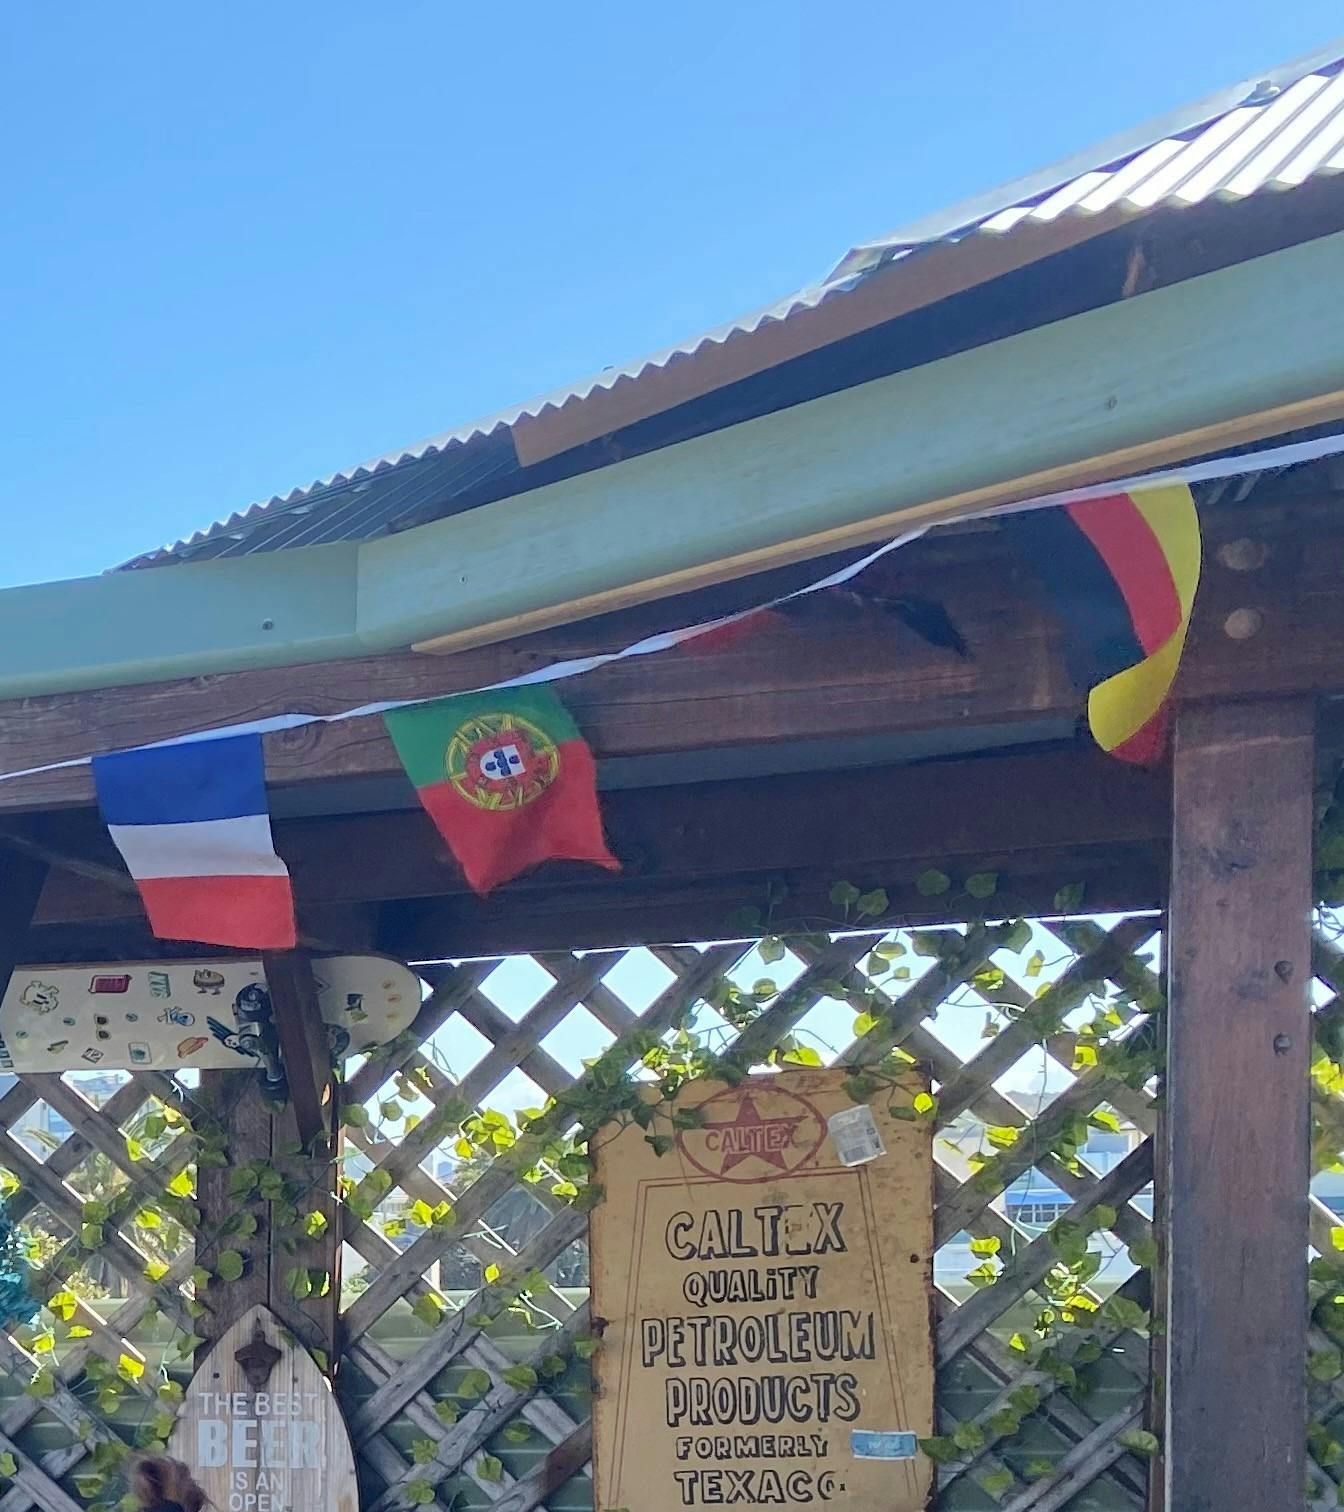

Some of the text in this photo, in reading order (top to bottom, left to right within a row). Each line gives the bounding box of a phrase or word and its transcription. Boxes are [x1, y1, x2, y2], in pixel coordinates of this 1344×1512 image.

[705, 1123, 800, 1154] CALTEX
[641, 1310, 876, 1367] PETROLEUM
[198, 1391, 319, 1416] THE BEST
[665, 1373, 862, 1427] PRODUCTS
[198, 1418, 321, 1468] BEER
[675, 1434, 828, 1460] FORMERLY
[230, 1471, 284, 1490] IS AN
[229, 1492, 284, 1512] OPEN
